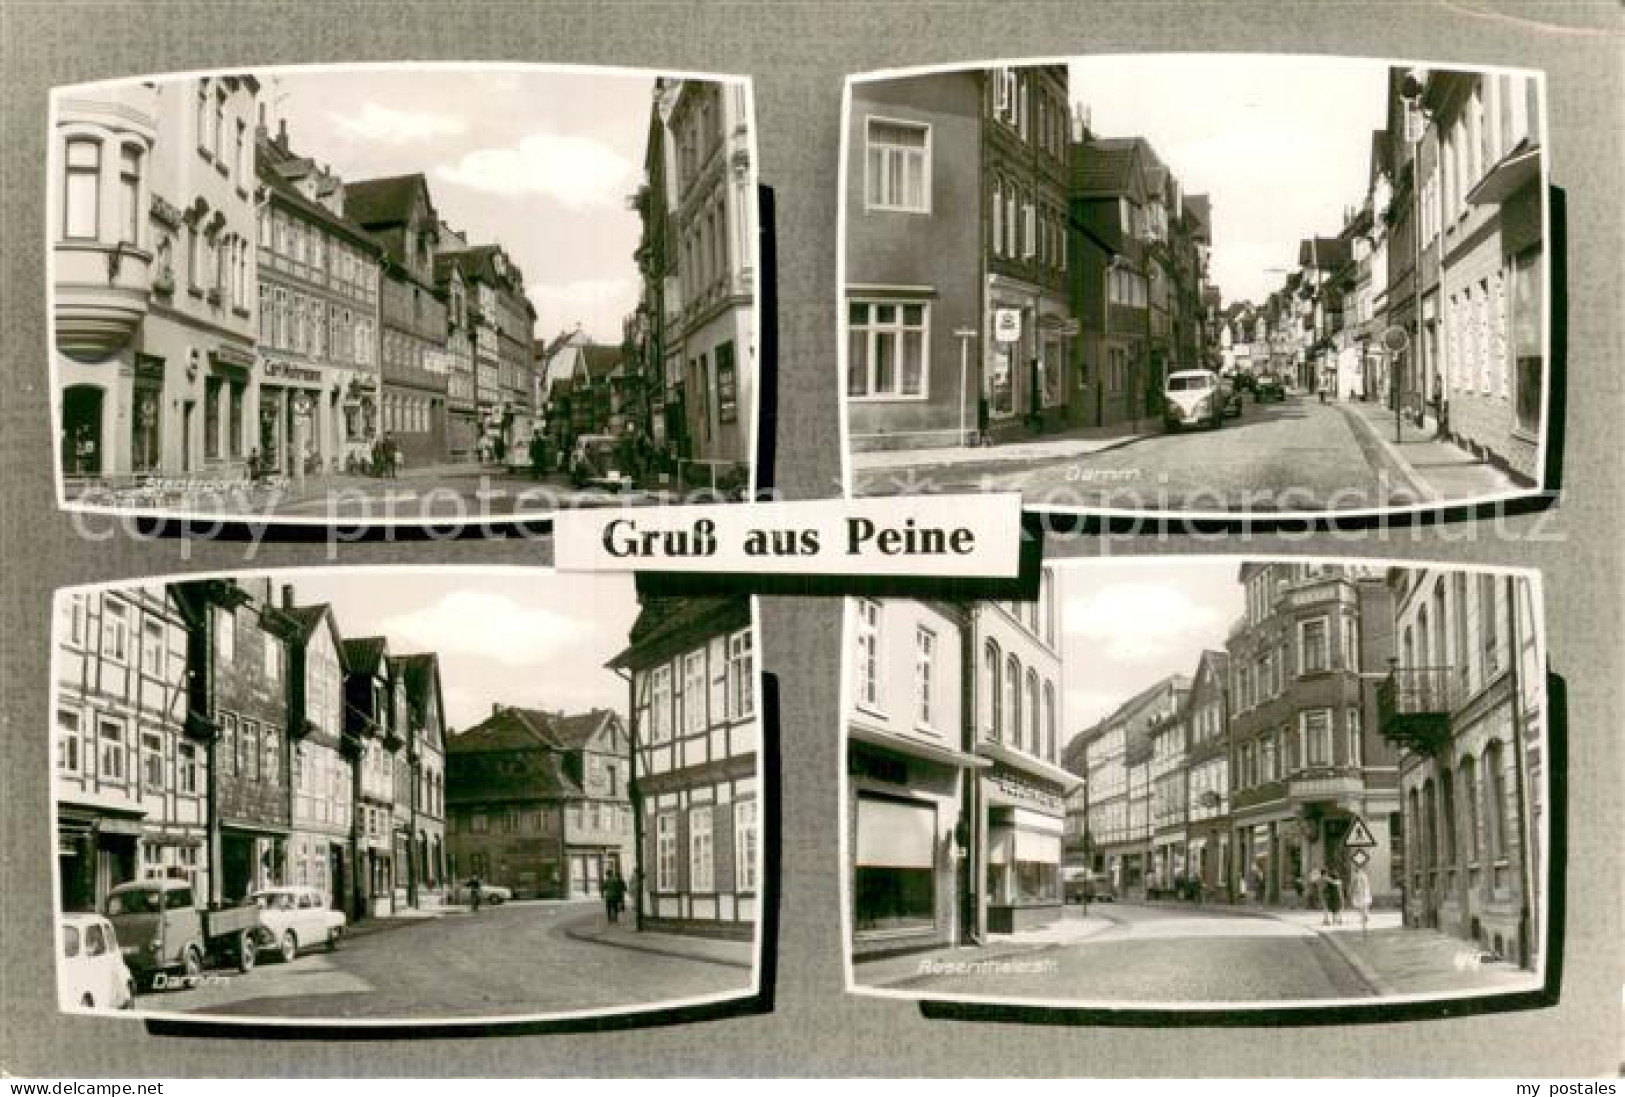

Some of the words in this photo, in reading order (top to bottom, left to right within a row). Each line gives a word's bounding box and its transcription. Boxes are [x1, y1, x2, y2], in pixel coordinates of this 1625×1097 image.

[603, 520, 715, 557] Gruß
[745, 530, 819, 555] aus
[848, 518, 973, 554] Peine
